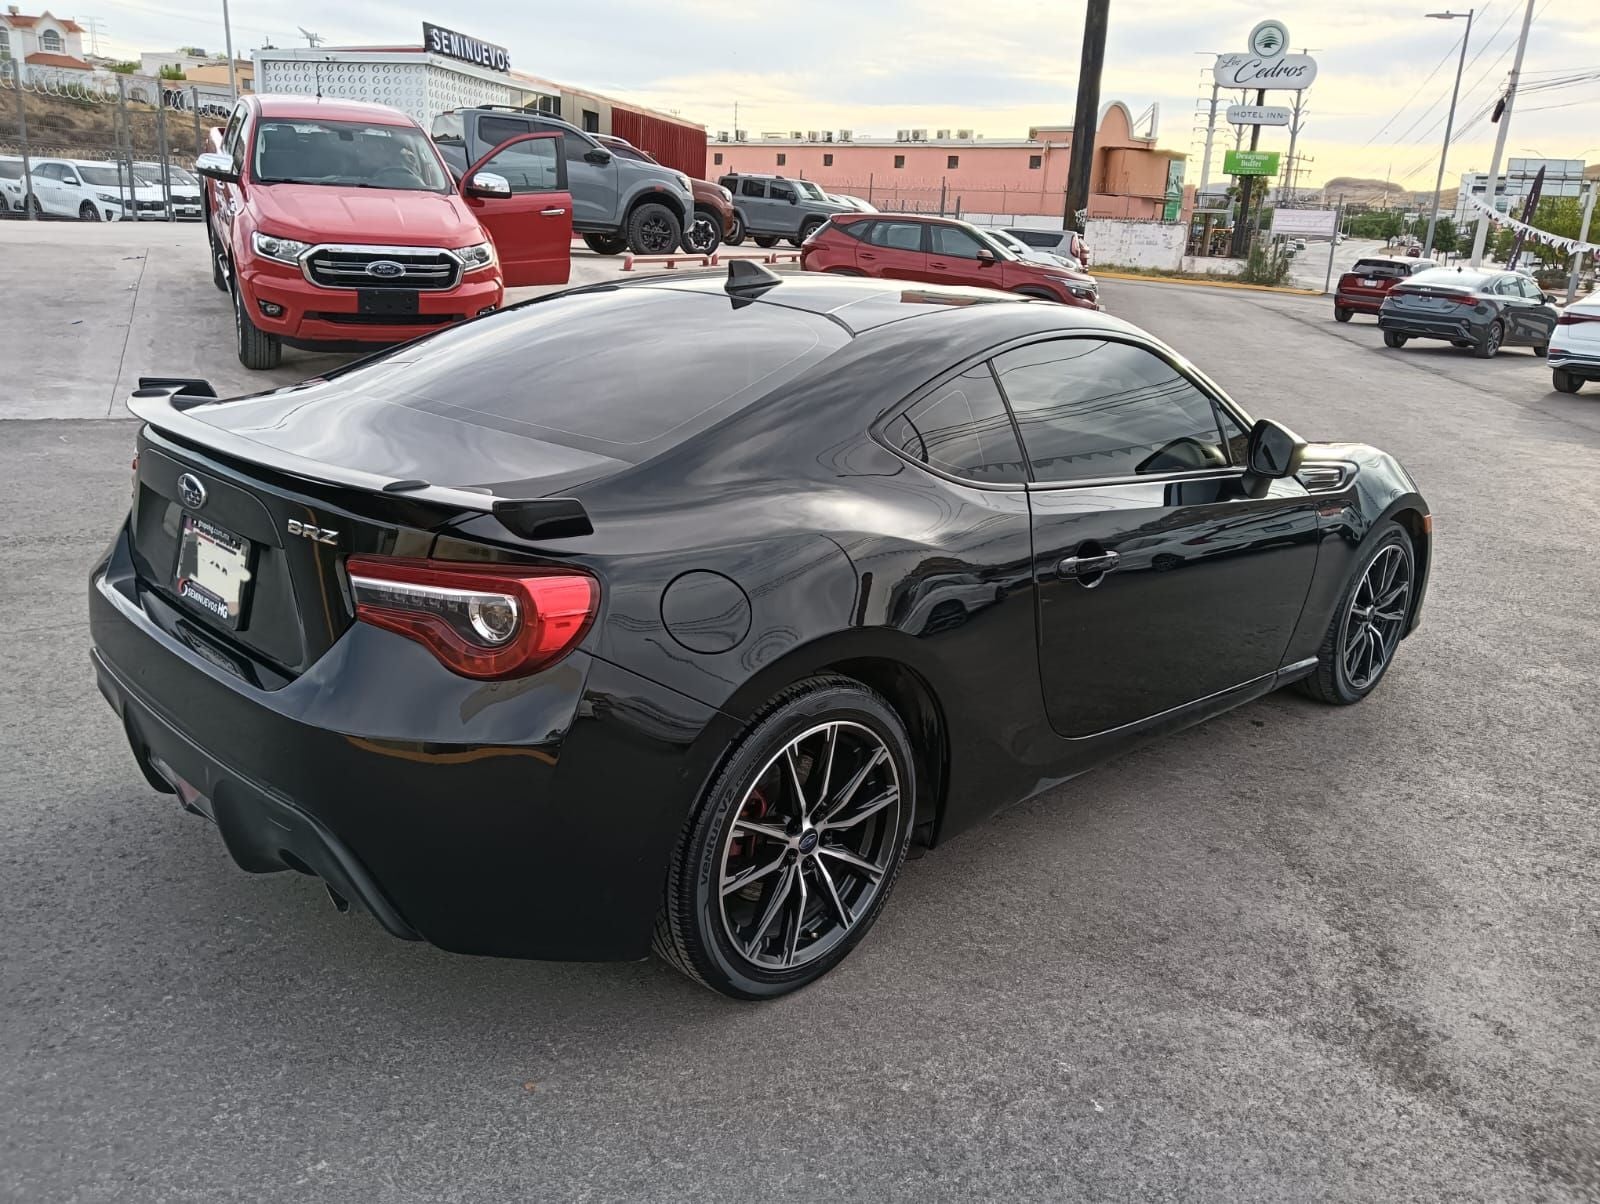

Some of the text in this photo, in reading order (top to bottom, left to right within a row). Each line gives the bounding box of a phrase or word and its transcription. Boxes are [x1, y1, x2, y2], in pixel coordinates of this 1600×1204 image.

[431, 27, 512, 71] SEMINUEVOS
[1233, 58, 1307, 83] Cedros
[1233, 111, 1263, 119] HOTEL
[287, 518, 339, 546] BRZ
[188, 587, 218, 613] SEMINUEVOS
[217, 601, 228, 619] HG
